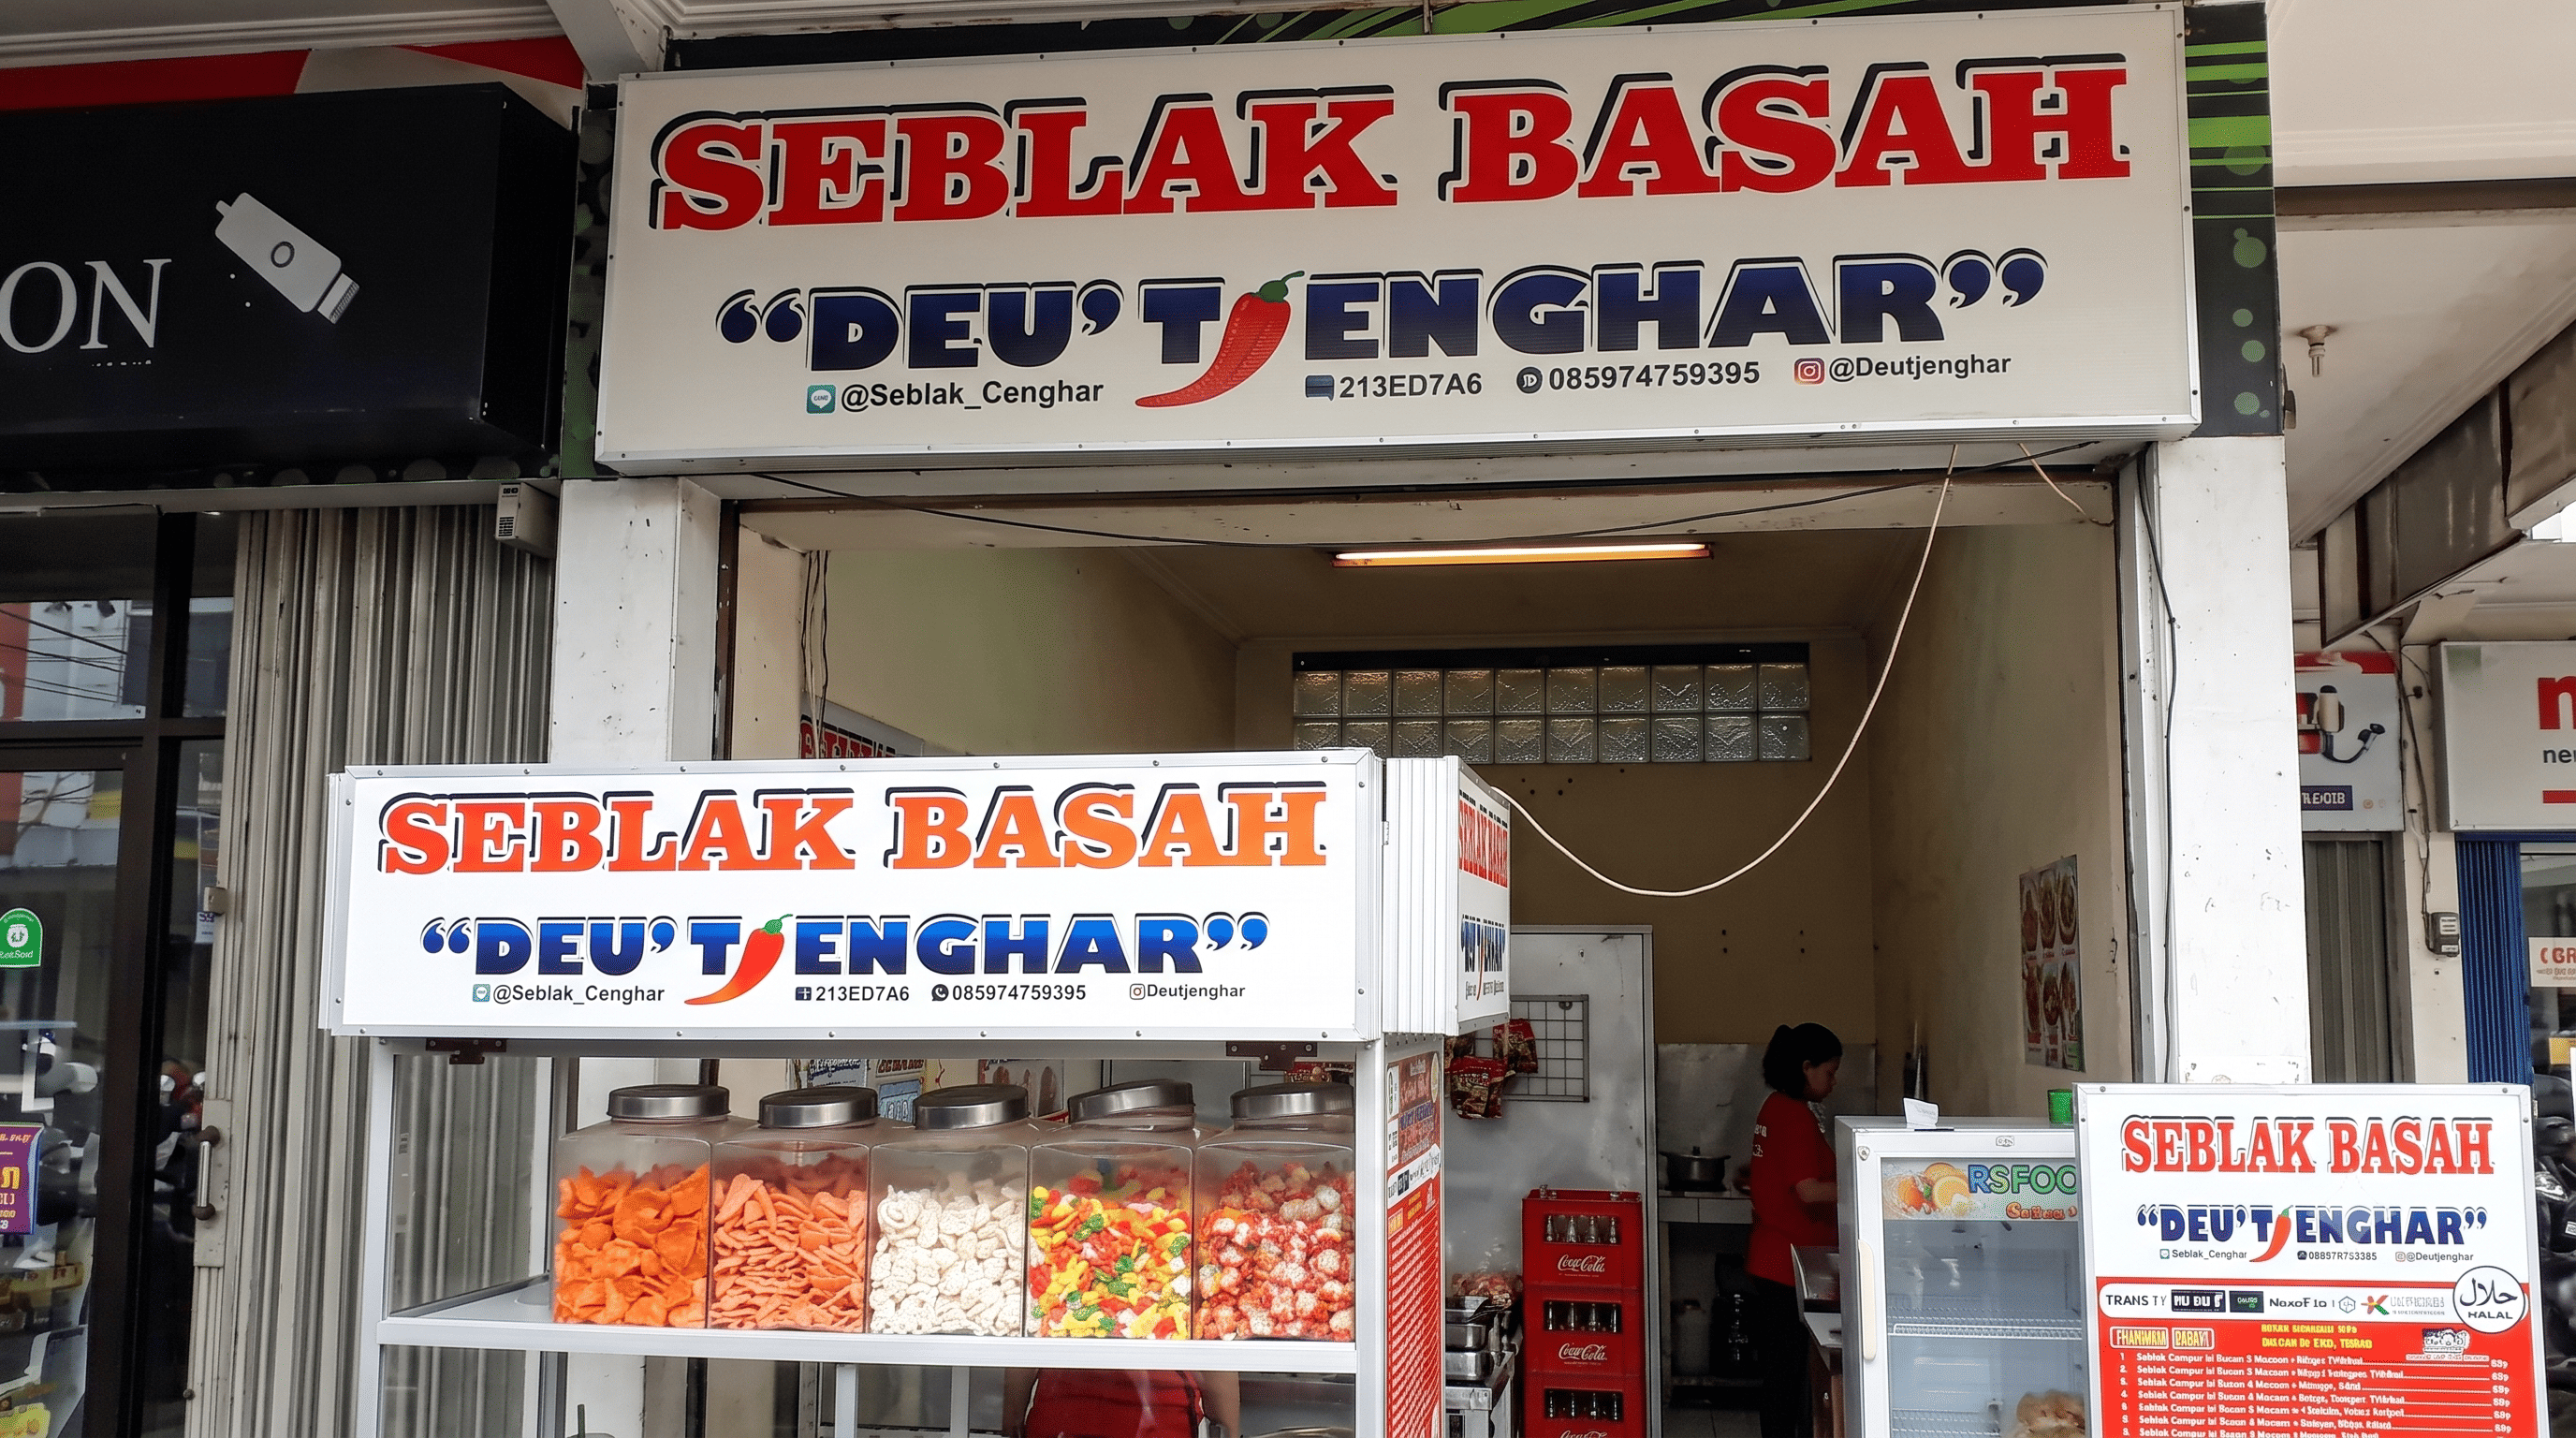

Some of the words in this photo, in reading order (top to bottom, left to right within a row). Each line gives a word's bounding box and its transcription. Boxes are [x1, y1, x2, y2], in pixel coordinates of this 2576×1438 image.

[650, 85, 1398, 231] SEBLAK
[1438, 53, 2130, 203] BASAH
[1548, 360, 1761, 391] 085974759395
[1828, 355, 2012, 383] @Deutjenghar
[841, 379, 1105, 413] @Seblak_Cenghar
[1339, 373, 1483, 399] 213ED7A6
[378, 788, 855, 874] SEBLAK
[885, 781, 1326, 870] BASAH
[493, 984, 666, 1005] @Seblak_Cenghar
[816, 985, 911, 1002] 213ED7A6
[951, 984, 1087, 1002] 085974759395
[1147, 983, 1246, 1002] Deutjenghar
[2121, 1114, 2317, 1173] SEBLAK
[2326, 1117, 2496, 1175] BASAH
[2105, 1294, 2149, 1307] TRANS
